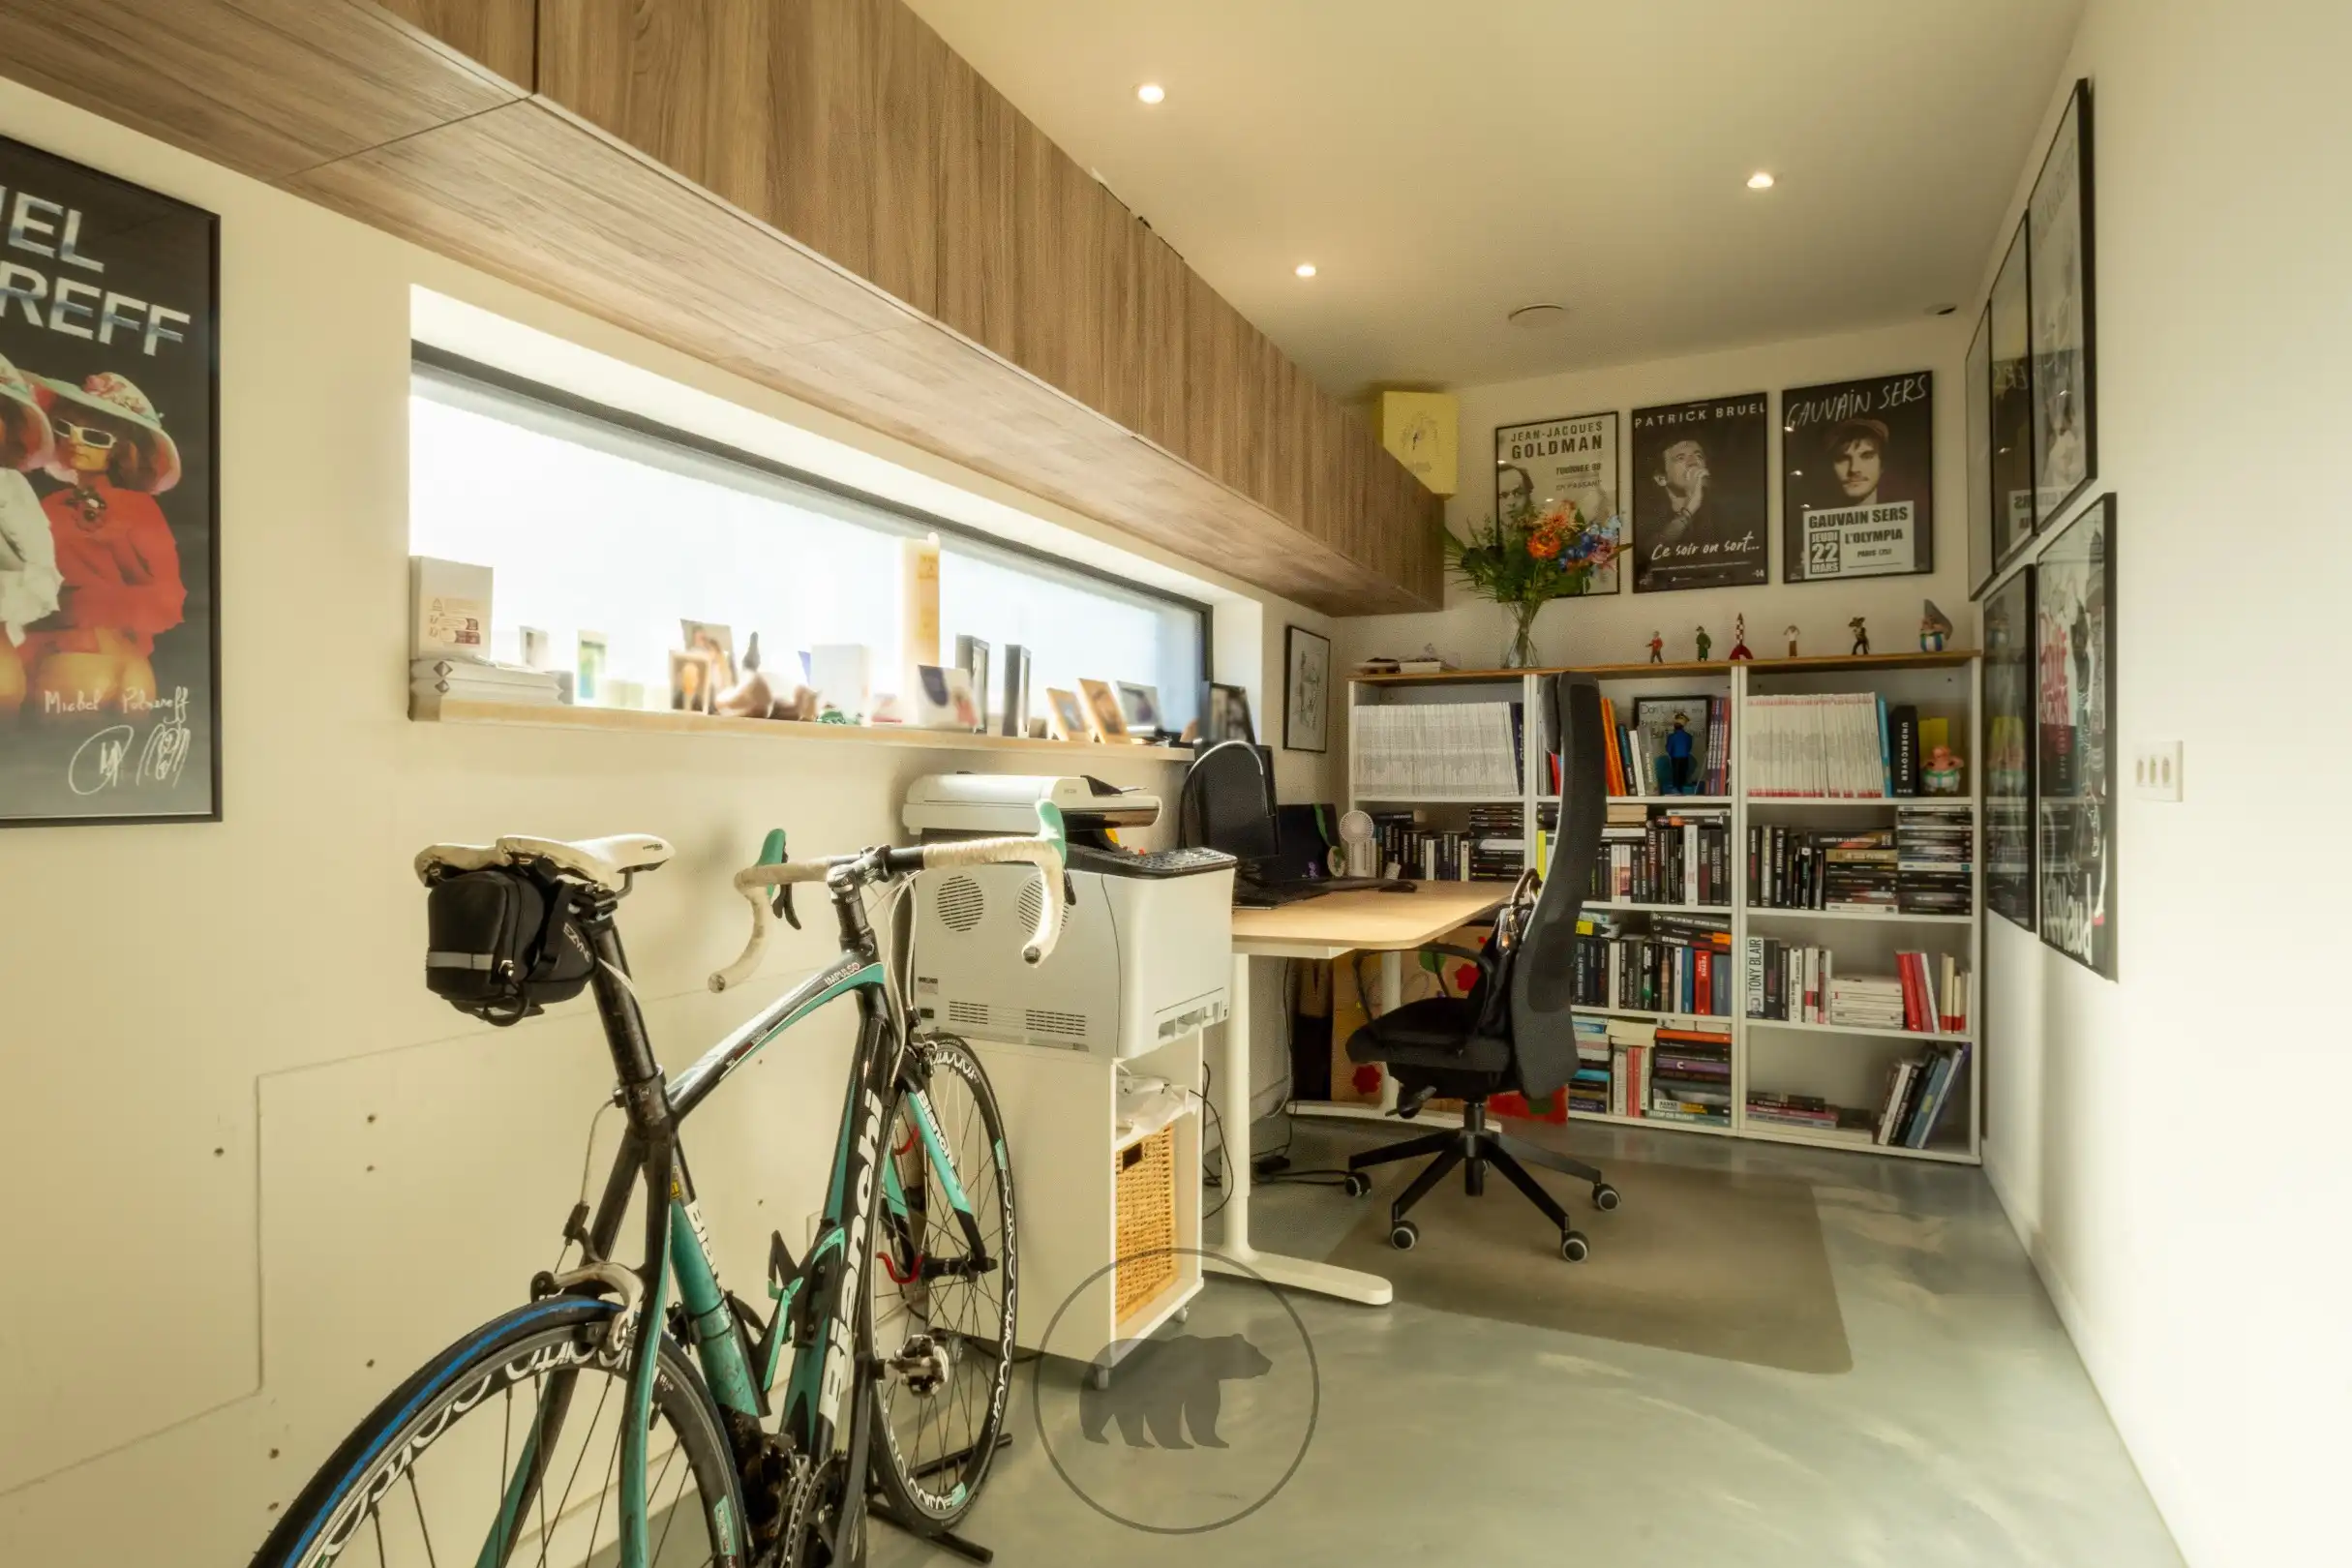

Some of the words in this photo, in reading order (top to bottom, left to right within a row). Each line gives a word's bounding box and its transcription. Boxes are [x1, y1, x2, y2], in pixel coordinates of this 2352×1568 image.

[0, 185, 105, 273] EL
[0, 259, 191, 356] REFF
[1878, 374, 1927, 409] SERS
[1635, 409, 1706, 429] PATRICK
[1715, 402, 1765, 418] BRUEL
[1511, 420, 1603, 442] JEAN-JACQUES
[1511, 435, 1603, 460] GOLDMAN
[1872, 506, 1908, 524] SERS
[1811, 531, 1838, 543] JEUDI
[1845, 528, 1904, 545] L'OLYMPIA
[1651, 543, 1671, 560] Ce
[1675, 542, 1700, 557] soir
[1703, 543, 1719, 555] on
[1811, 542, 1839, 563] 22
[1811, 562, 1839, 573] MARS
[1900, 721, 1909, 782] UNDERCOVER
[1748, 939, 1762, 966] BLAIR
[824, 961, 860, 987] IMPULSO
[1748, 968, 1762, 992] TONY
[818, 1088, 883, 1431] Bianchi
